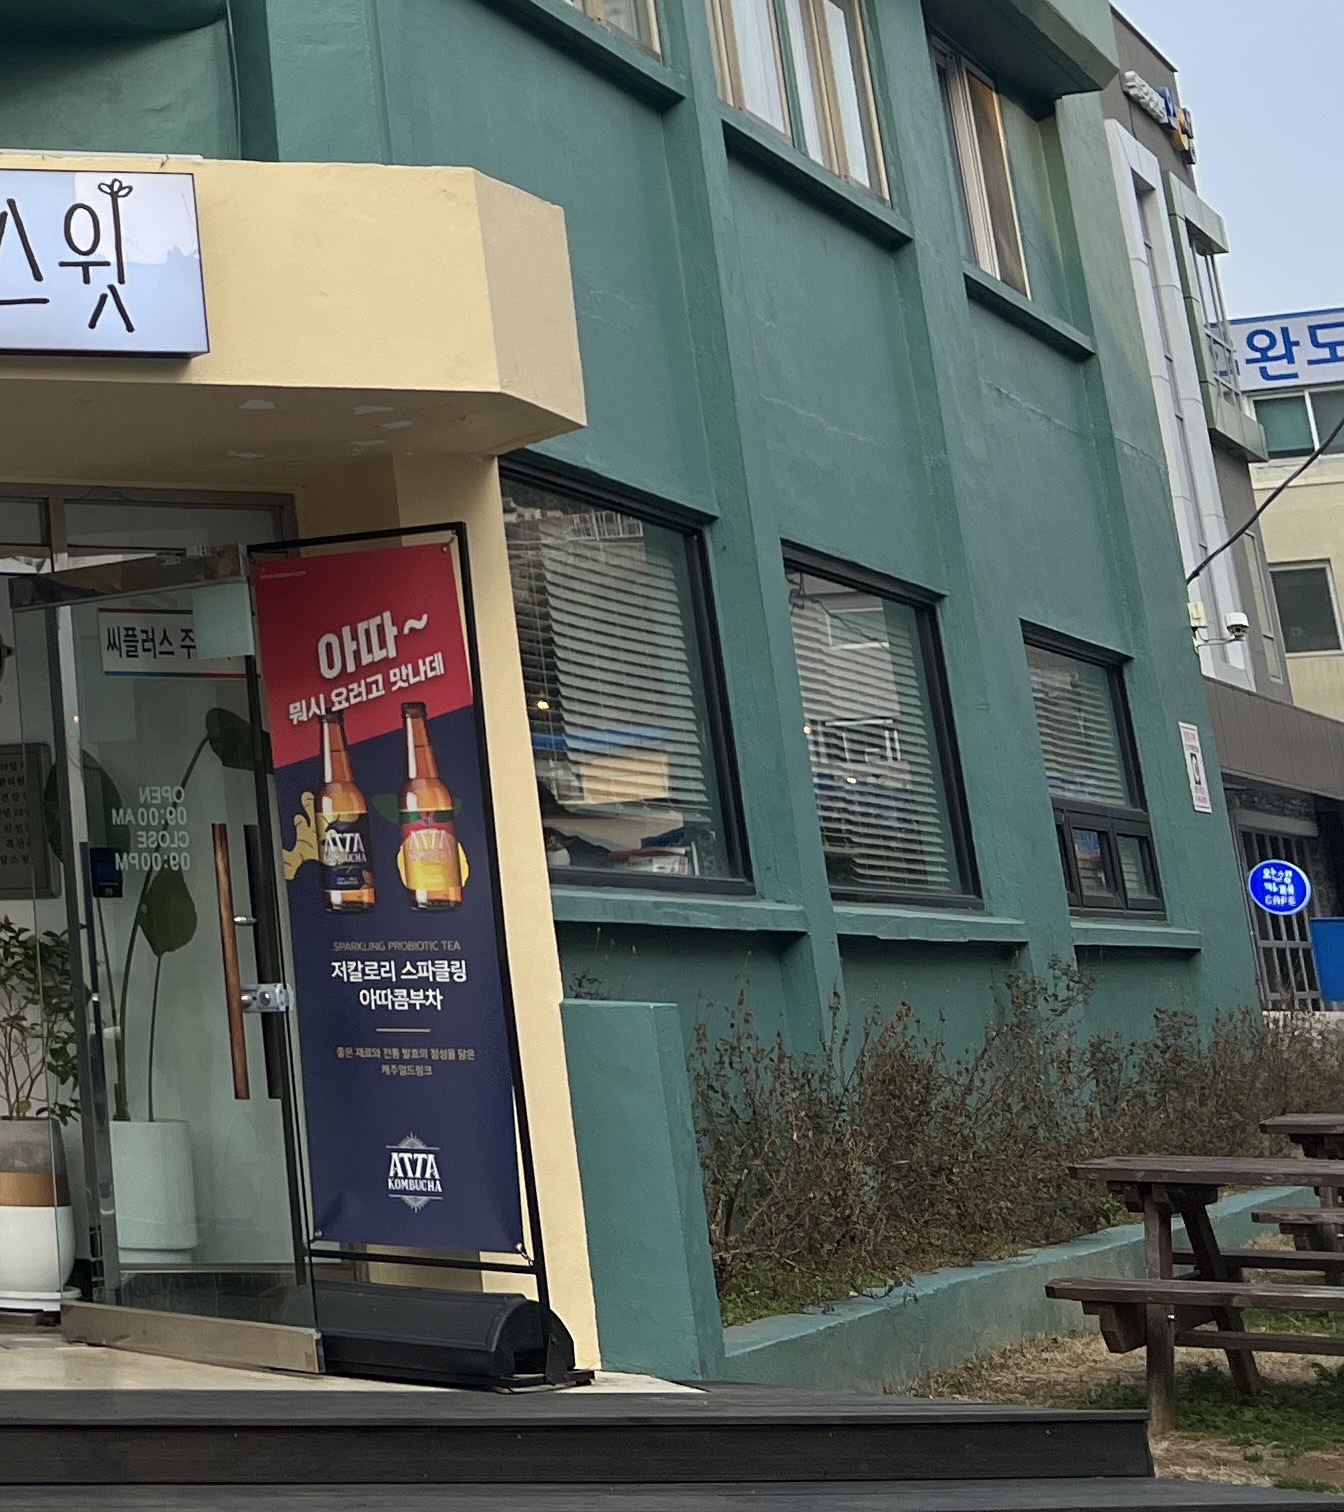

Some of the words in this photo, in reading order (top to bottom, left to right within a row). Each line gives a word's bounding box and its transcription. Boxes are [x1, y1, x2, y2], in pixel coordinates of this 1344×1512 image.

[106, 625, 175, 660] 씨플러스
[289, 693, 326, 725] 뭐시
[331, 673, 386, 712] 요러고
[334, 941, 385, 952] SPARKLING
[388, 941, 439, 951] PROBIOTIC
[442, 940, 461, 951] TEA
[331, 960, 396, 982] 저칼로리
[400, 959, 467, 982] 스파클링
[359, 988, 443, 1010] 아따콤부차
[388, 1152, 440, 1179] ATTA
[387, 1178, 442, 1192] KOMBUCHA
